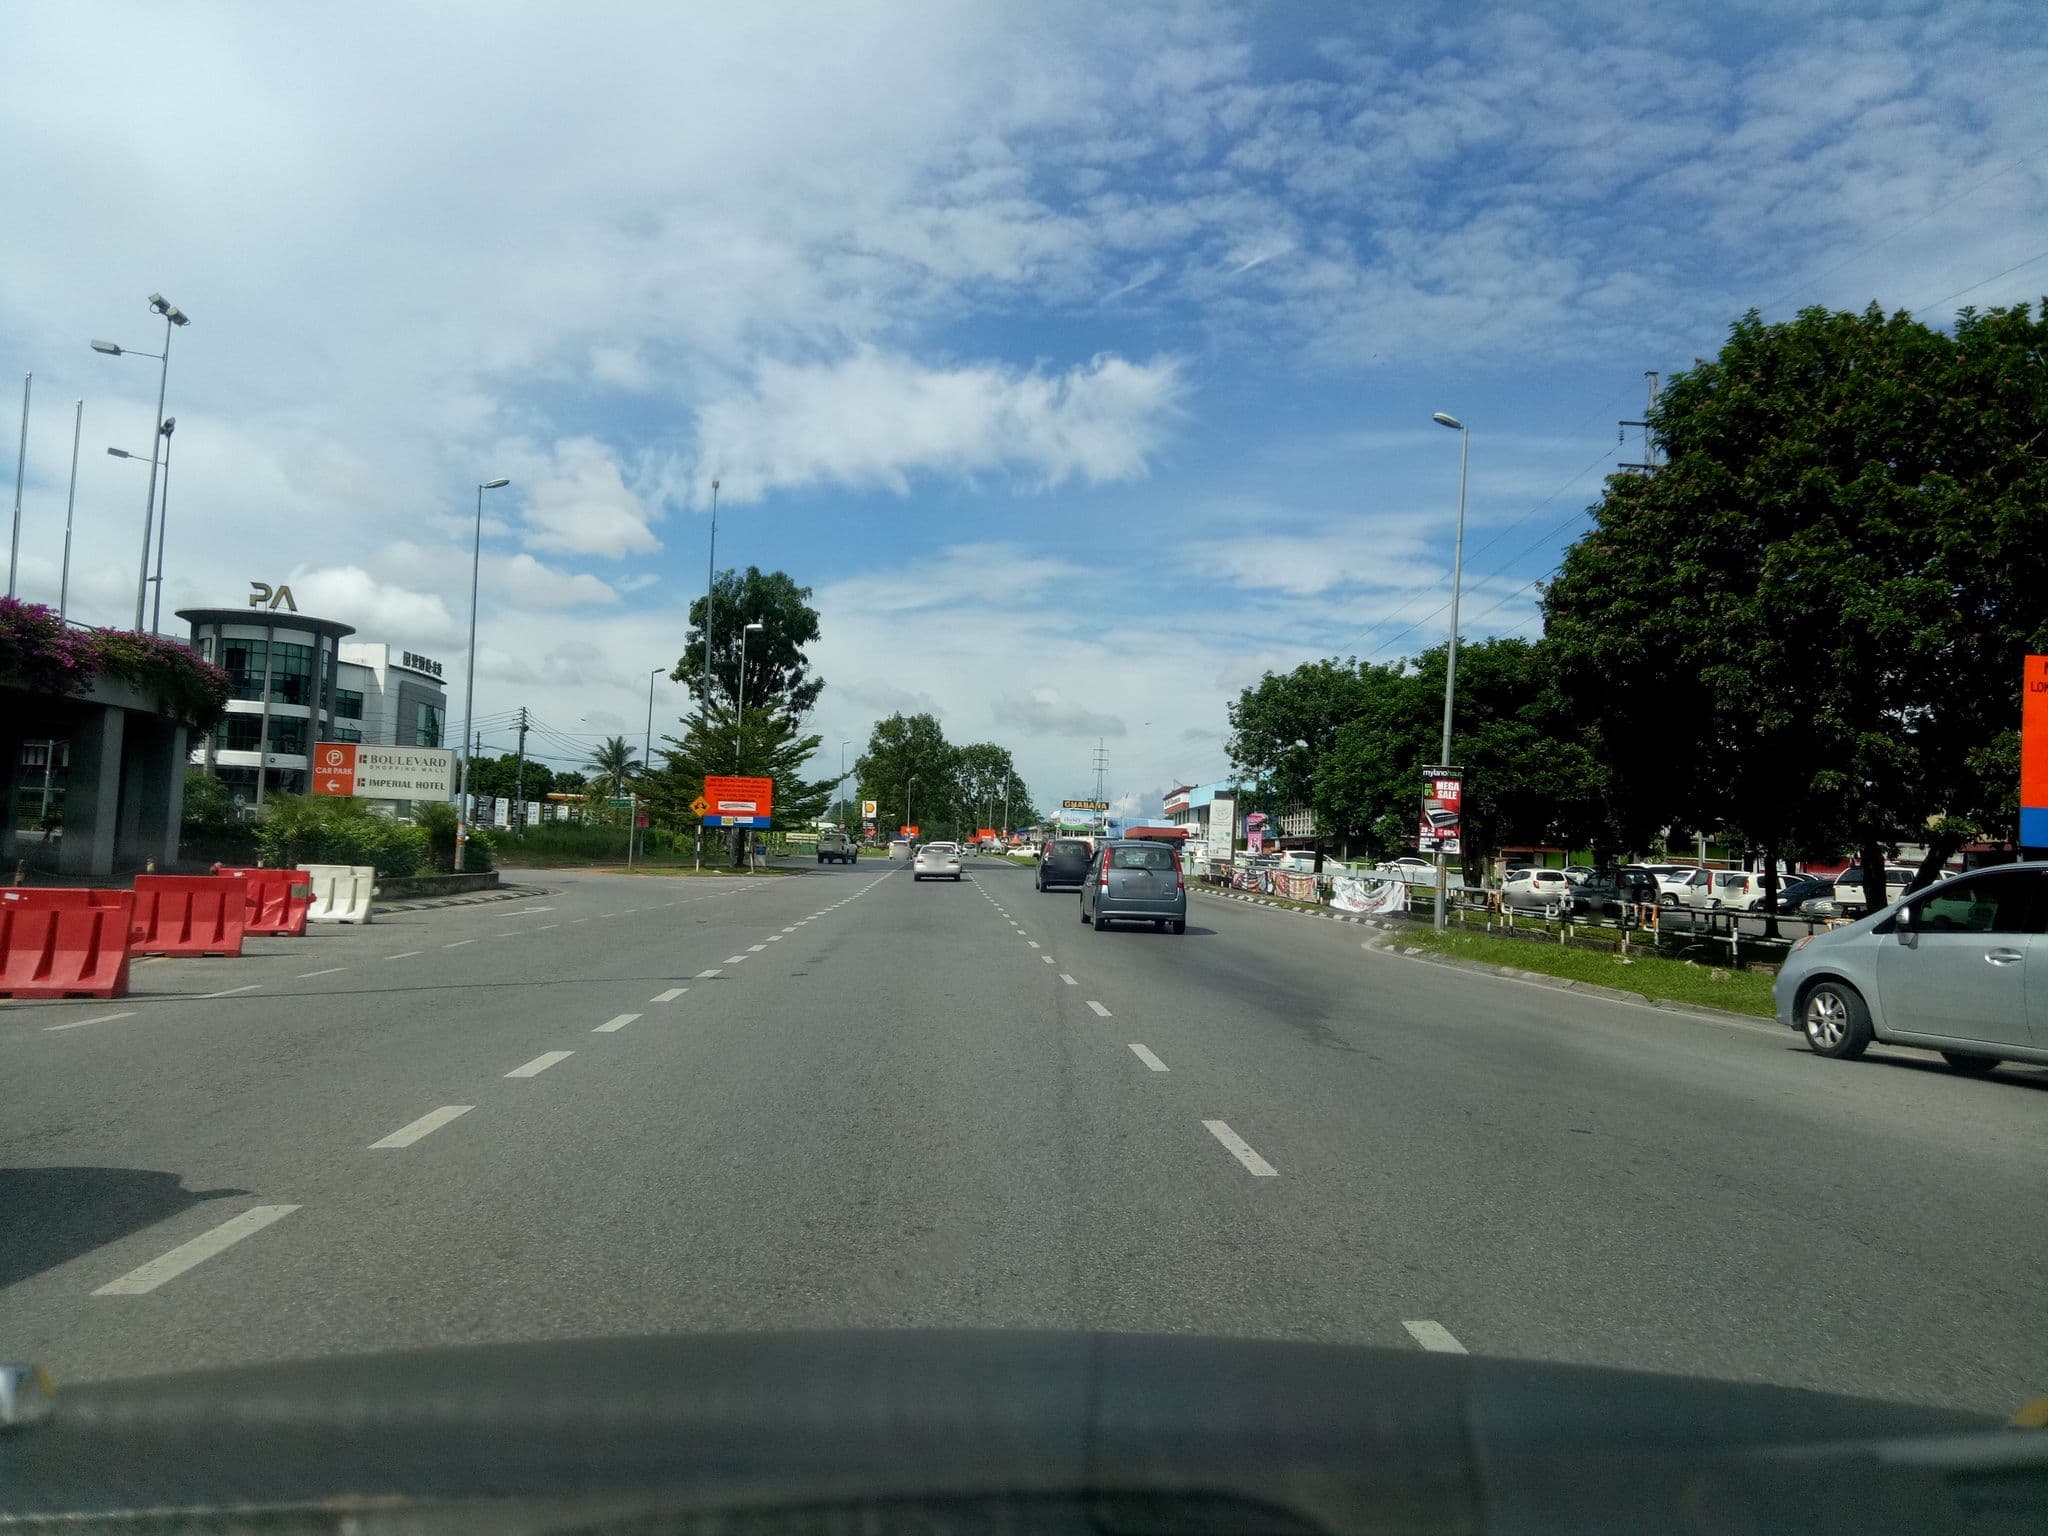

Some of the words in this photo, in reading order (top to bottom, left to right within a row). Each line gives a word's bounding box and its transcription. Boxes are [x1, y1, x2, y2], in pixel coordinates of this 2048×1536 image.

[249, 581, 298, 612] PA
[370, 754, 447, 768] BOULEVARD
[315, 766, 332, 775] CAR
[333, 767, 352, 775] PARK
[369, 764, 417, 772] SHOPPING
[369, 778, 412, 789] IMPERIAL
[415, 781, 446, 791] HOTEL
[1436, 781, 1460, 791] MEGA
[1437, 790, 1457, 800] SALE
